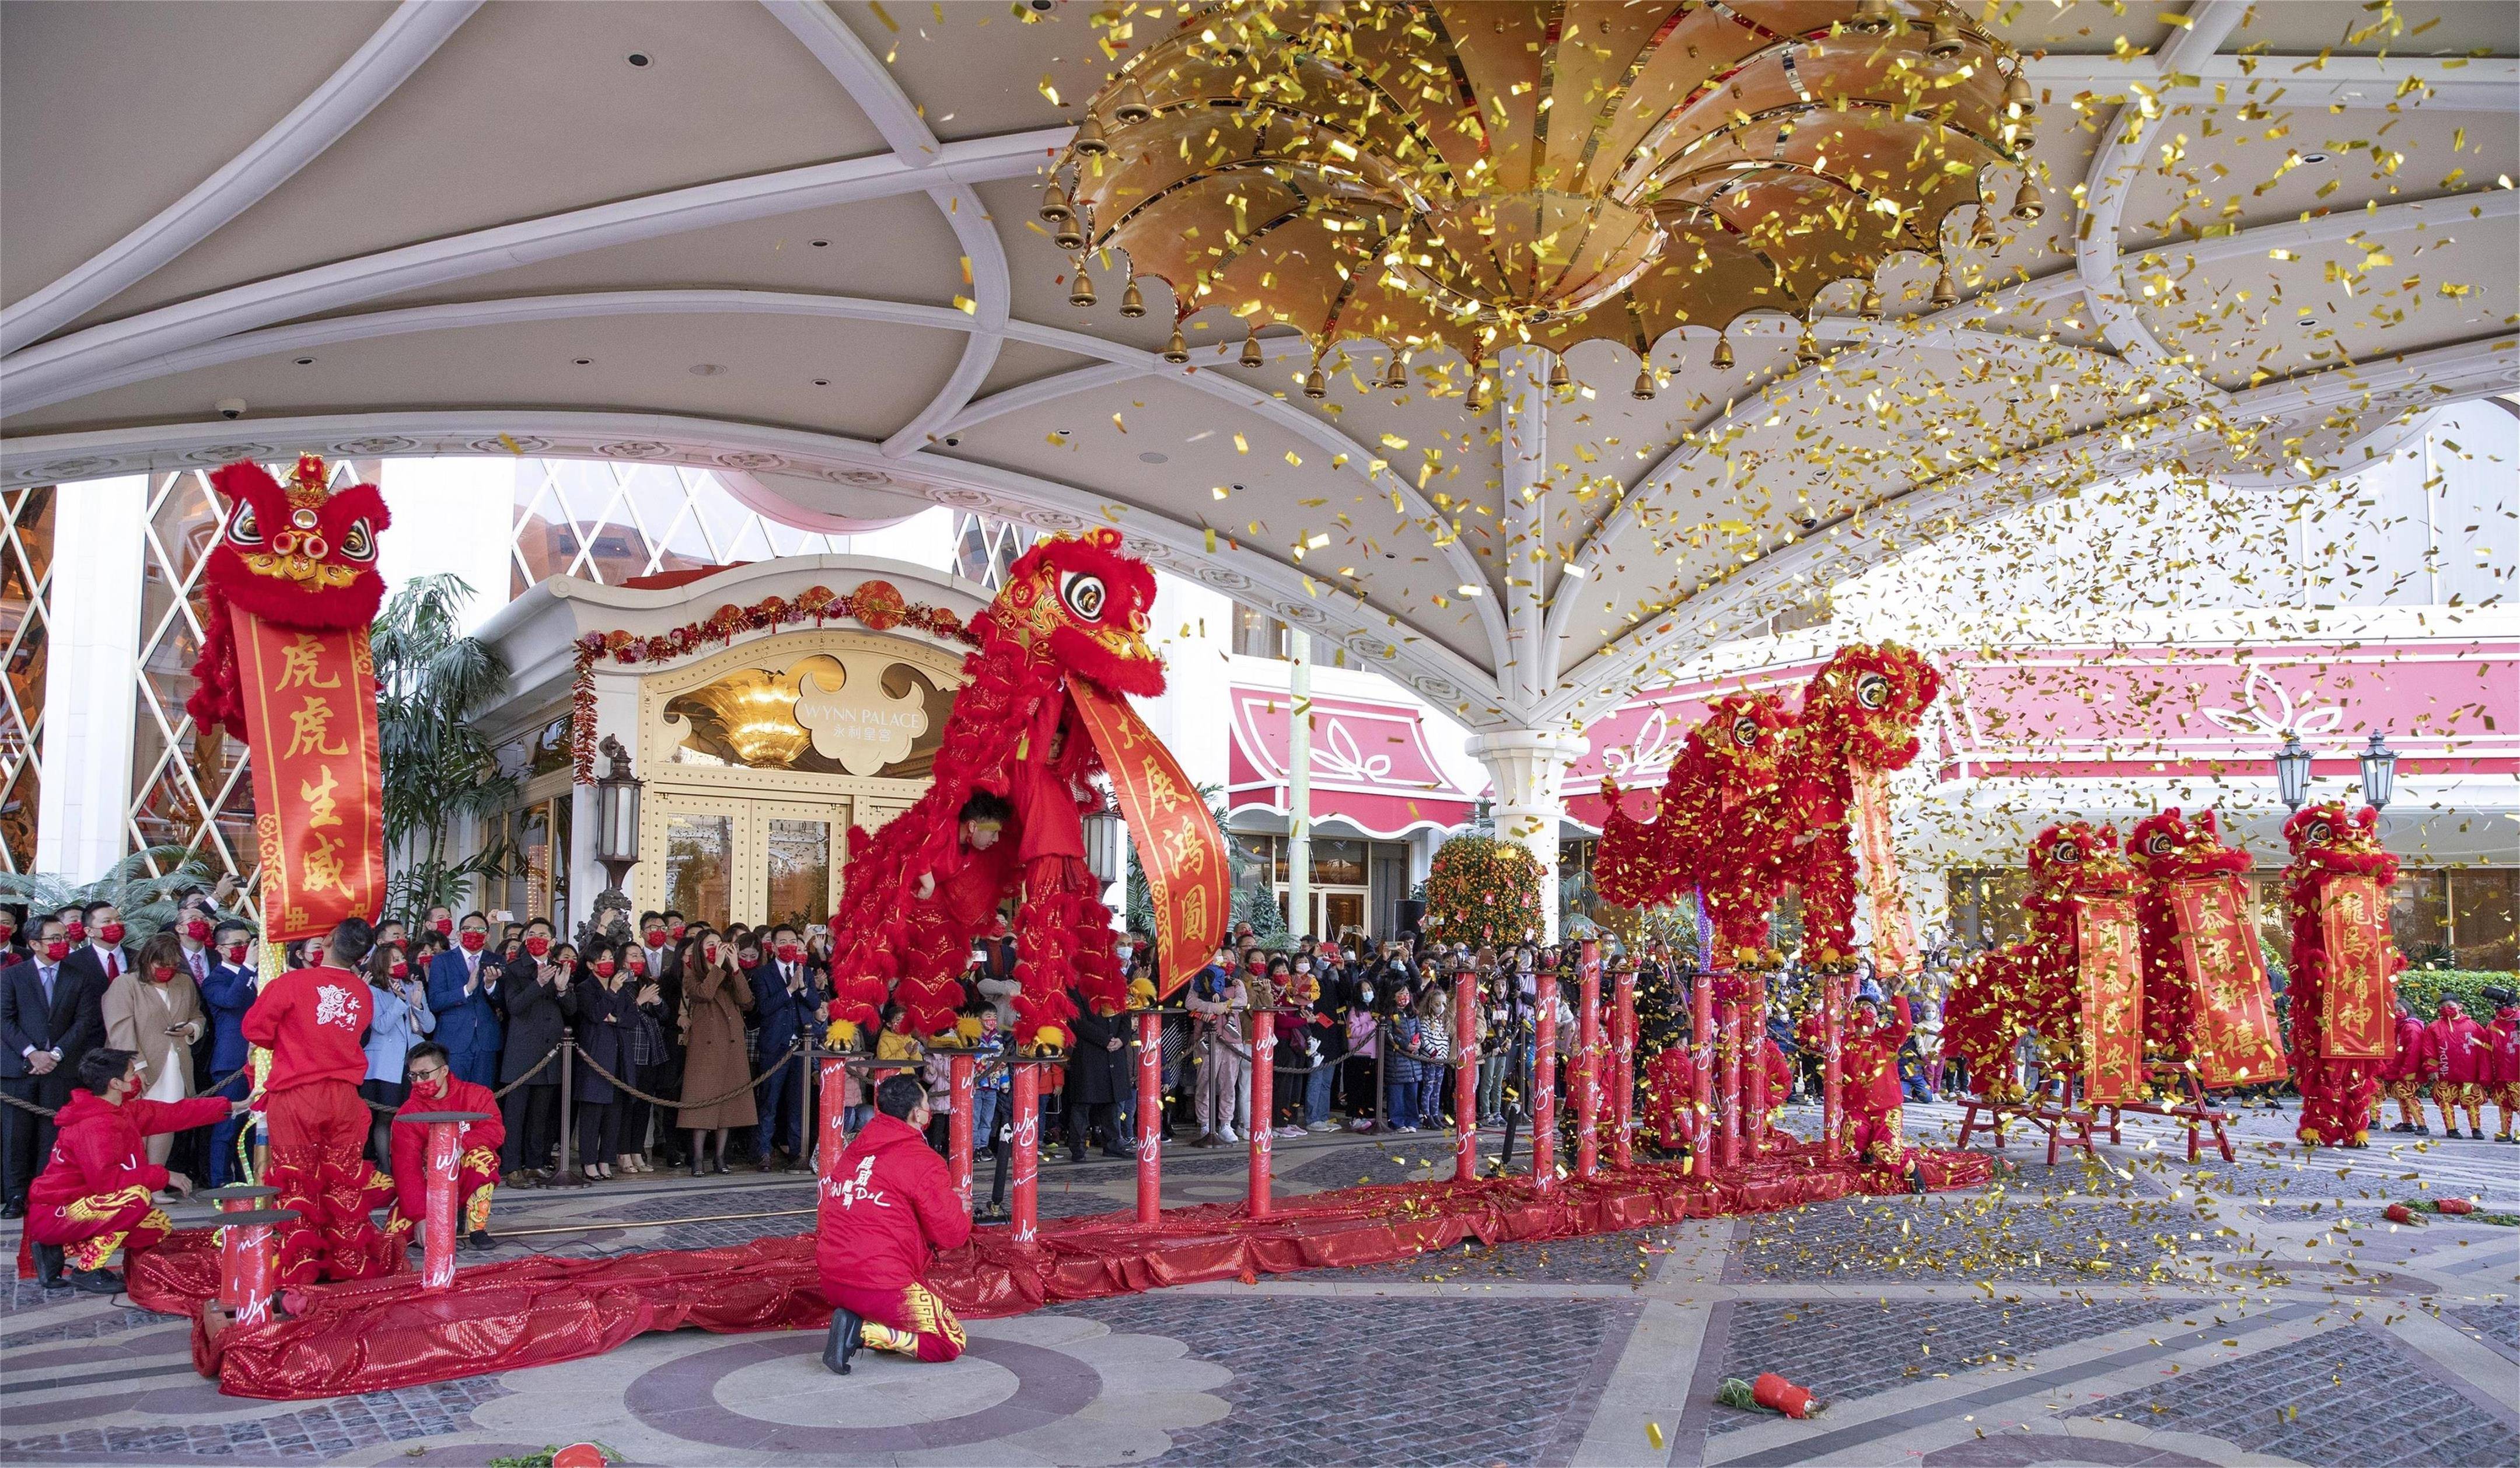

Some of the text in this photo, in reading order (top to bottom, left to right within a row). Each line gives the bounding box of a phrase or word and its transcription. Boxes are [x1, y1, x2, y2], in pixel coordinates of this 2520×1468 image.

[275, 634, 355, 901] 虎虎生威
[805, 704, 920, 729] WYNN PALACE
[833, 724, 892, 742] 永利皇宮
[2197, 893, 2262, 1059] 恭賀新禧
[2337, 890, 2374, 1038] 龍馬精神
